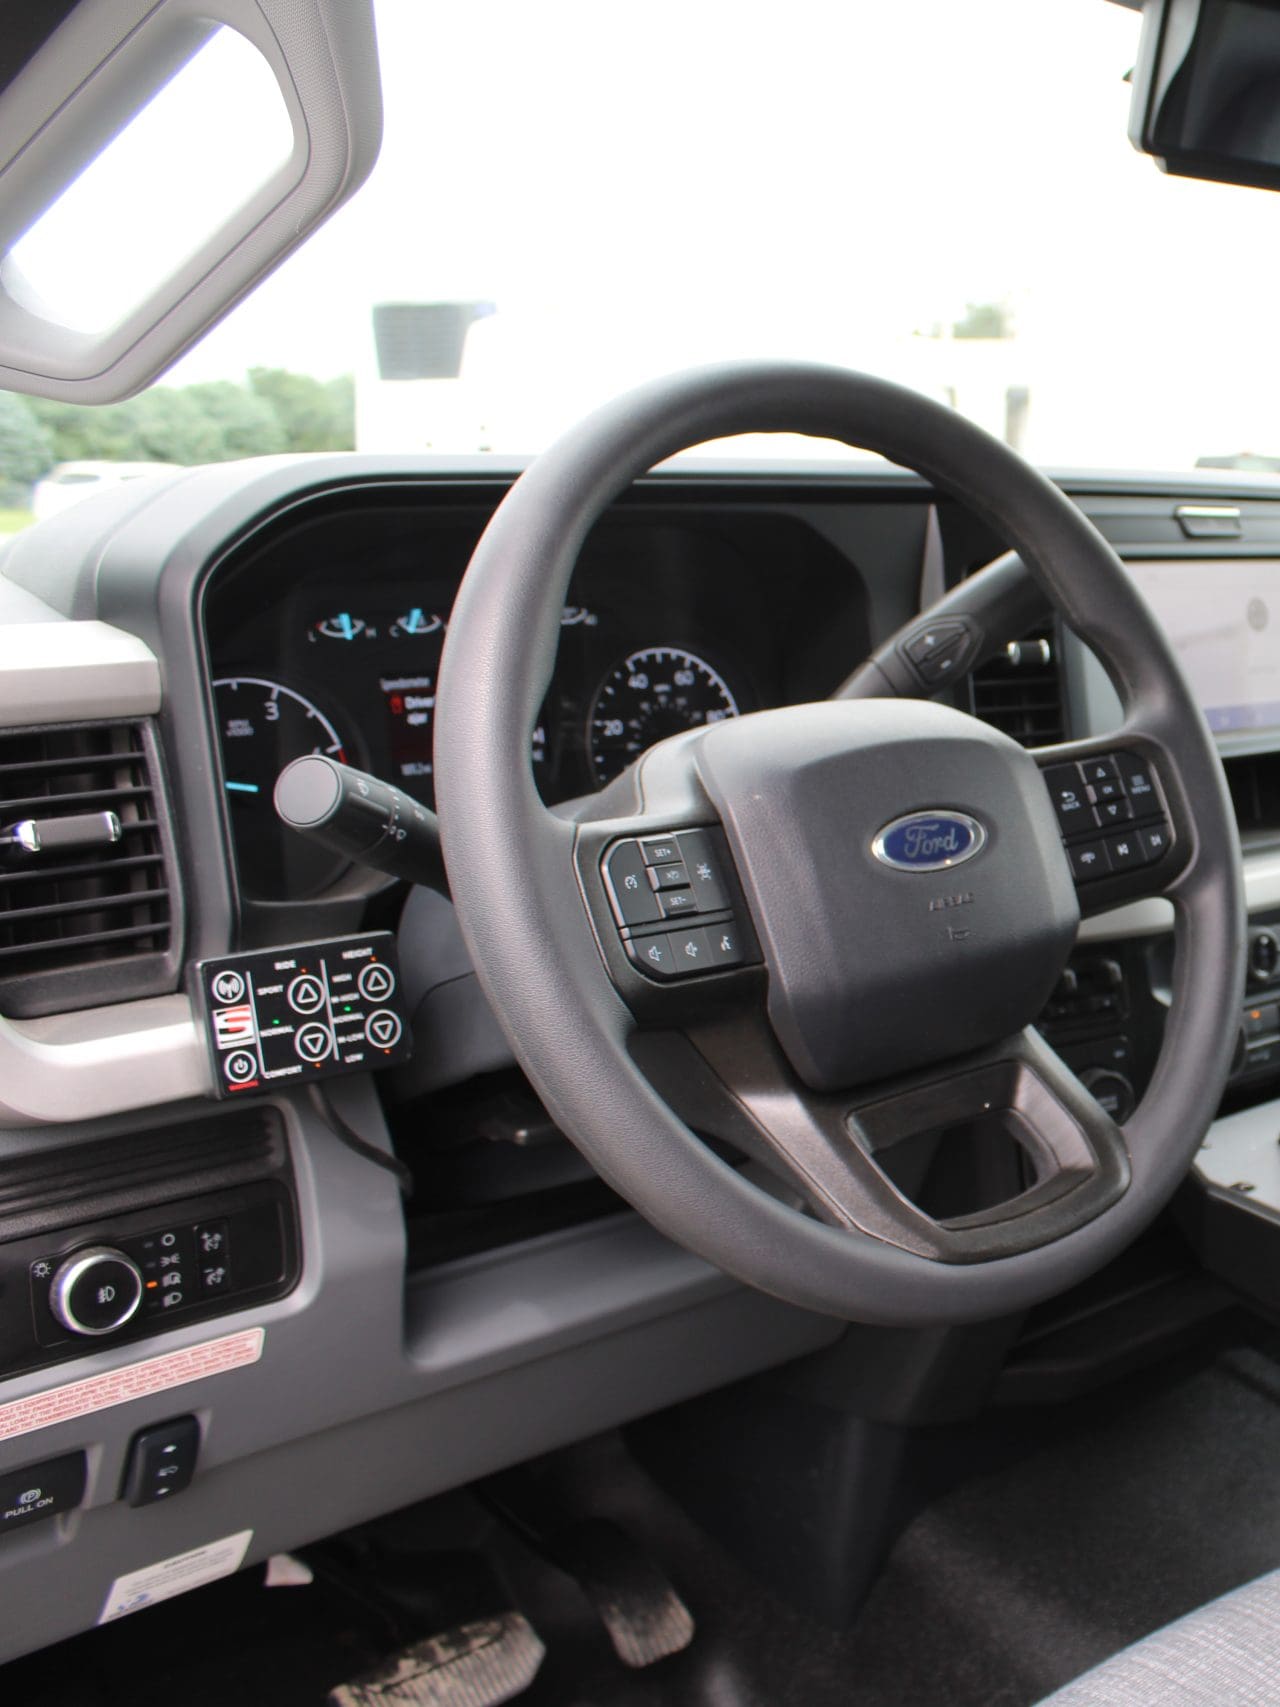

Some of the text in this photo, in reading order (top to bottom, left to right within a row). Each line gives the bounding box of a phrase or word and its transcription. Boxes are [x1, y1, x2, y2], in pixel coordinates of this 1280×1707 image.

[264, 701, 280, 720] 3
[603, 714, 624, 736] 20
[903, 823, 959, 859] Ford
[654, 848, 672, 858] SET+
[670, 896, 687, 906] SET-
[273, 960, 297, 971] RIDE
[256, 984, 284, 996] SPORT
[344, 1053, 364, 1064] LOW
[4, 1496, 54, 1519] PULL ON
